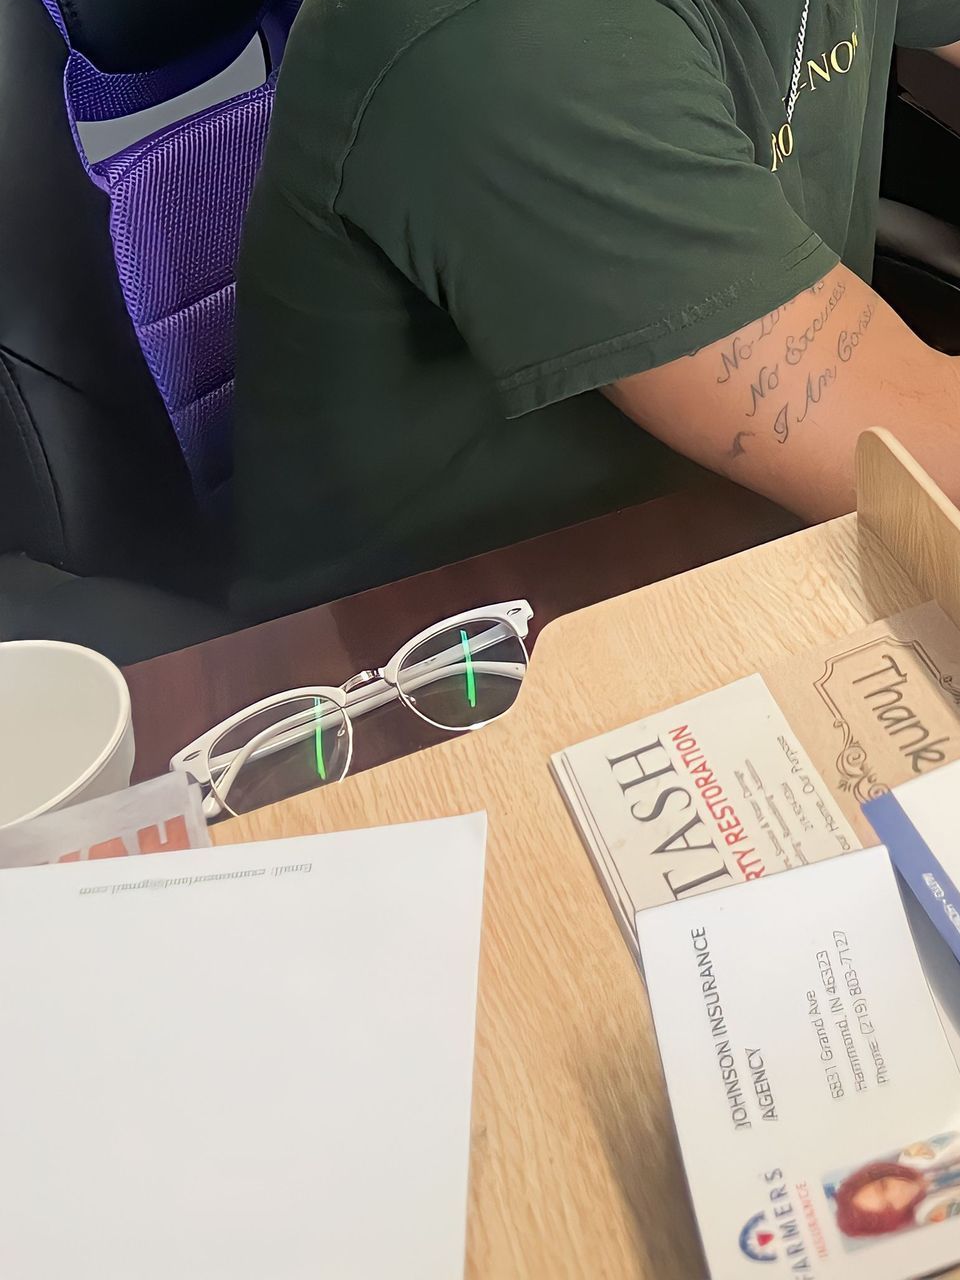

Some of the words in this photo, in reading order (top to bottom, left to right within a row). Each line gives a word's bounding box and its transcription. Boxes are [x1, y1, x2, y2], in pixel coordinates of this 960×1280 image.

[852, 654, 950, 773] Thank
[669, 724, 749, 847] RESTORATION
[691, 926, 728, 1038] INSURANCE
[806, 990, 821, 1015] Ave
[829, 998, 844, 1013] IN
[811, 1018, 833, 1061] Grand
[715, 1040, 752, 1131] JOHNSON
[745, 1047, 779, 1122] AGENCY
